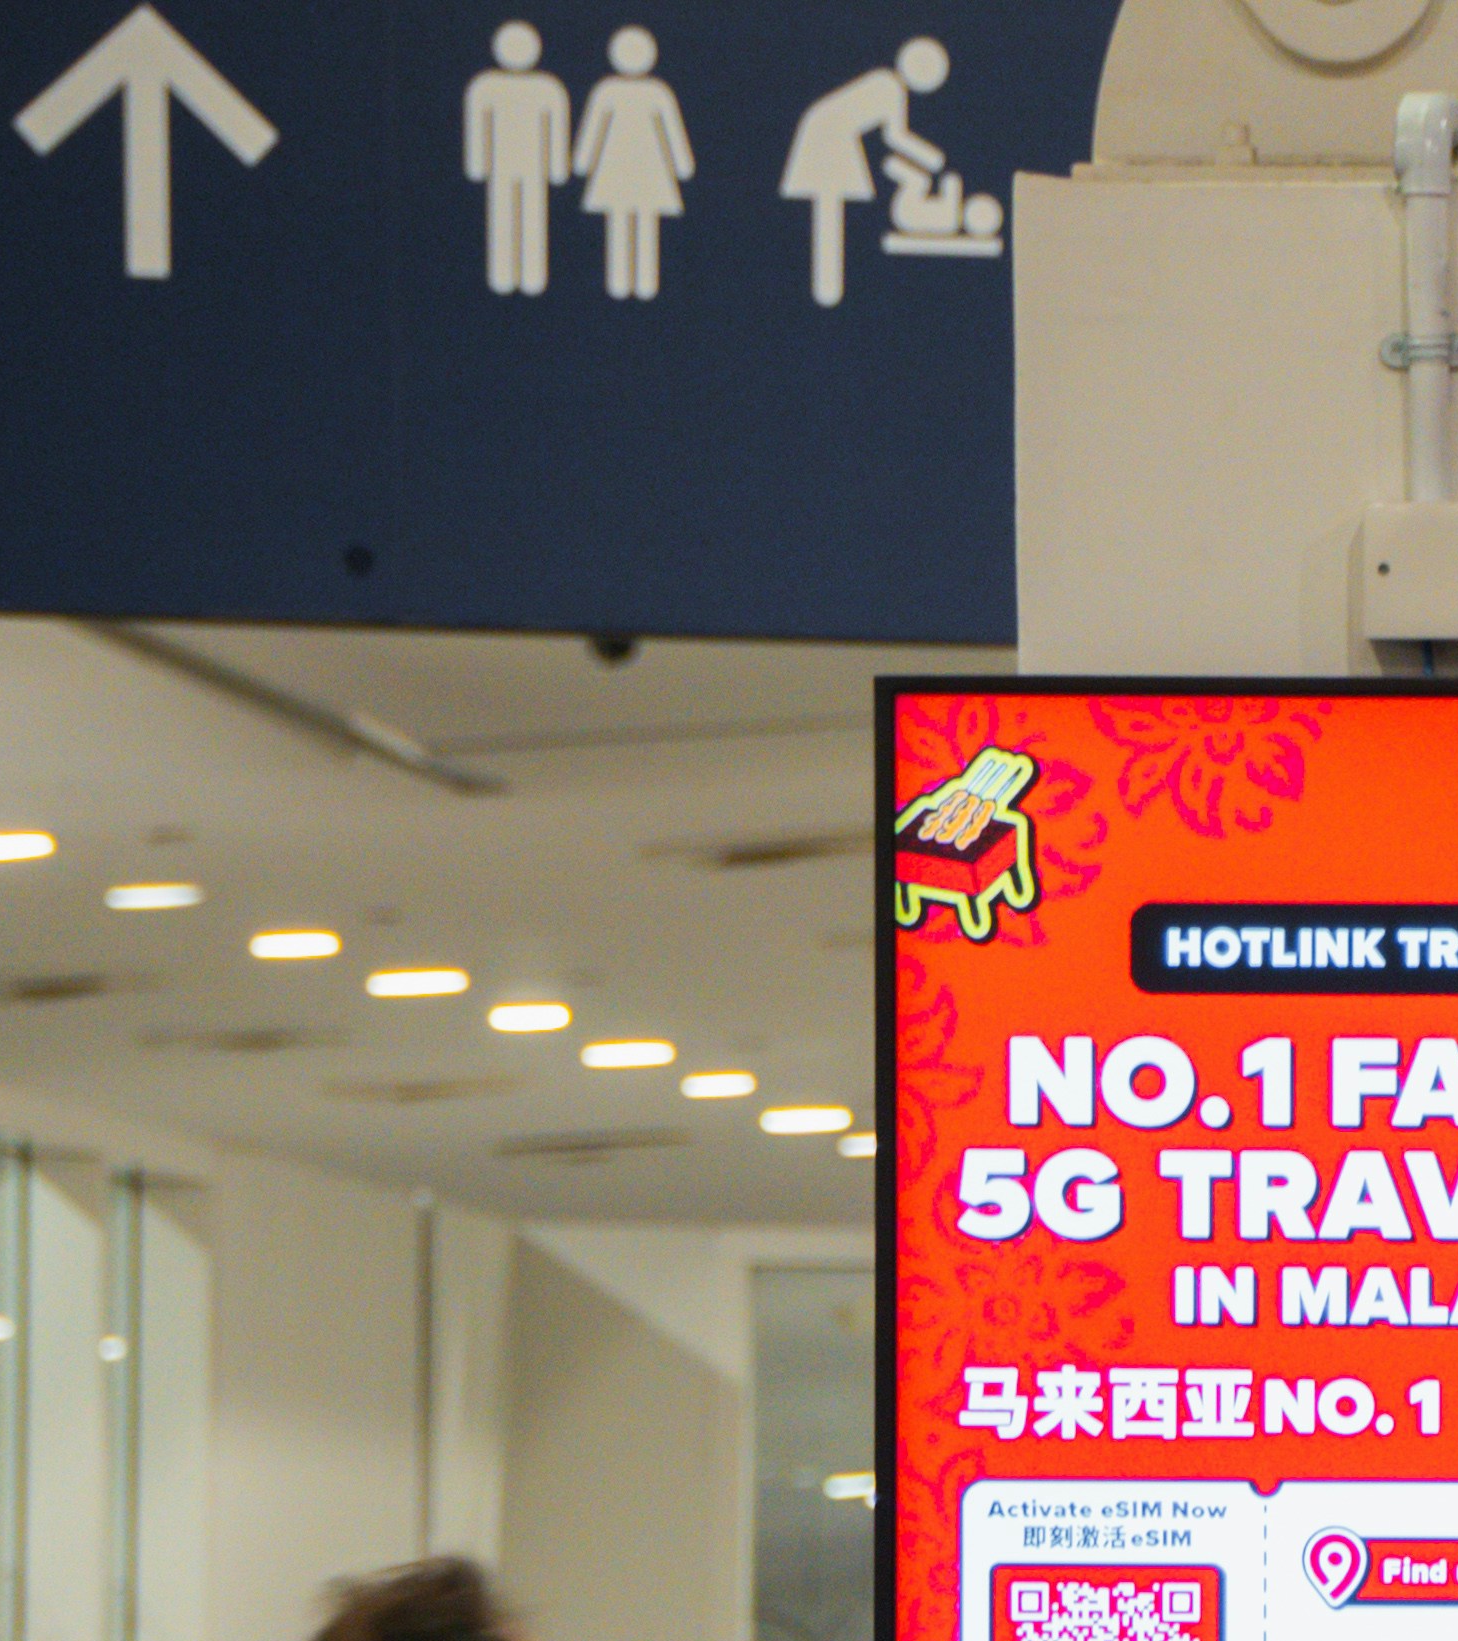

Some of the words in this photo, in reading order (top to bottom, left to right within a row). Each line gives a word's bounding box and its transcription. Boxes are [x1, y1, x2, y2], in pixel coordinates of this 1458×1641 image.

[1165, 925, 1387, 969] HOTLINK
[1009, 1035, 1293, 1129] NO.1
[957, 1147, 1122, 1241] 5G
[1174, 1265, 1256, 1325] IN
[987, 1499, 1093, 1519] Activate
[1100, 1500, 1163, 1519] eSIM
[1171, 1500, 1228, 1519] Now
[1382, 1555, 1448, 1585] Find
